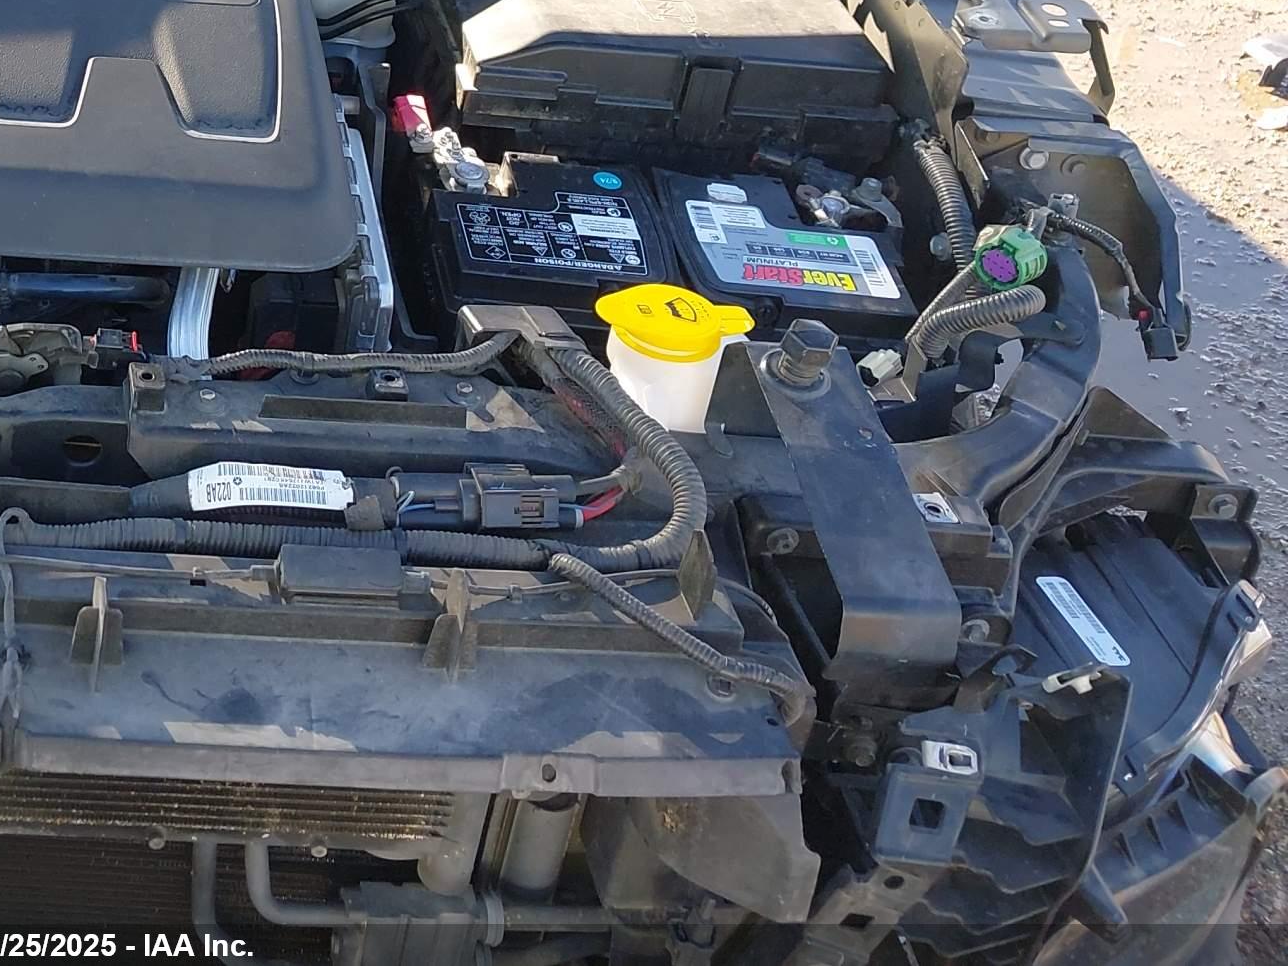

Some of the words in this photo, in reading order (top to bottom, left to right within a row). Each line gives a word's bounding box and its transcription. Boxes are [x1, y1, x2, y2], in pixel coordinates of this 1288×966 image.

[534, 257, 614, 270] DANGER/POISON
[746, 257, 799, 267] PLATINUM
[742, 264, 857, 292] EverStart
[205, 481, 232, 503] 022AB
